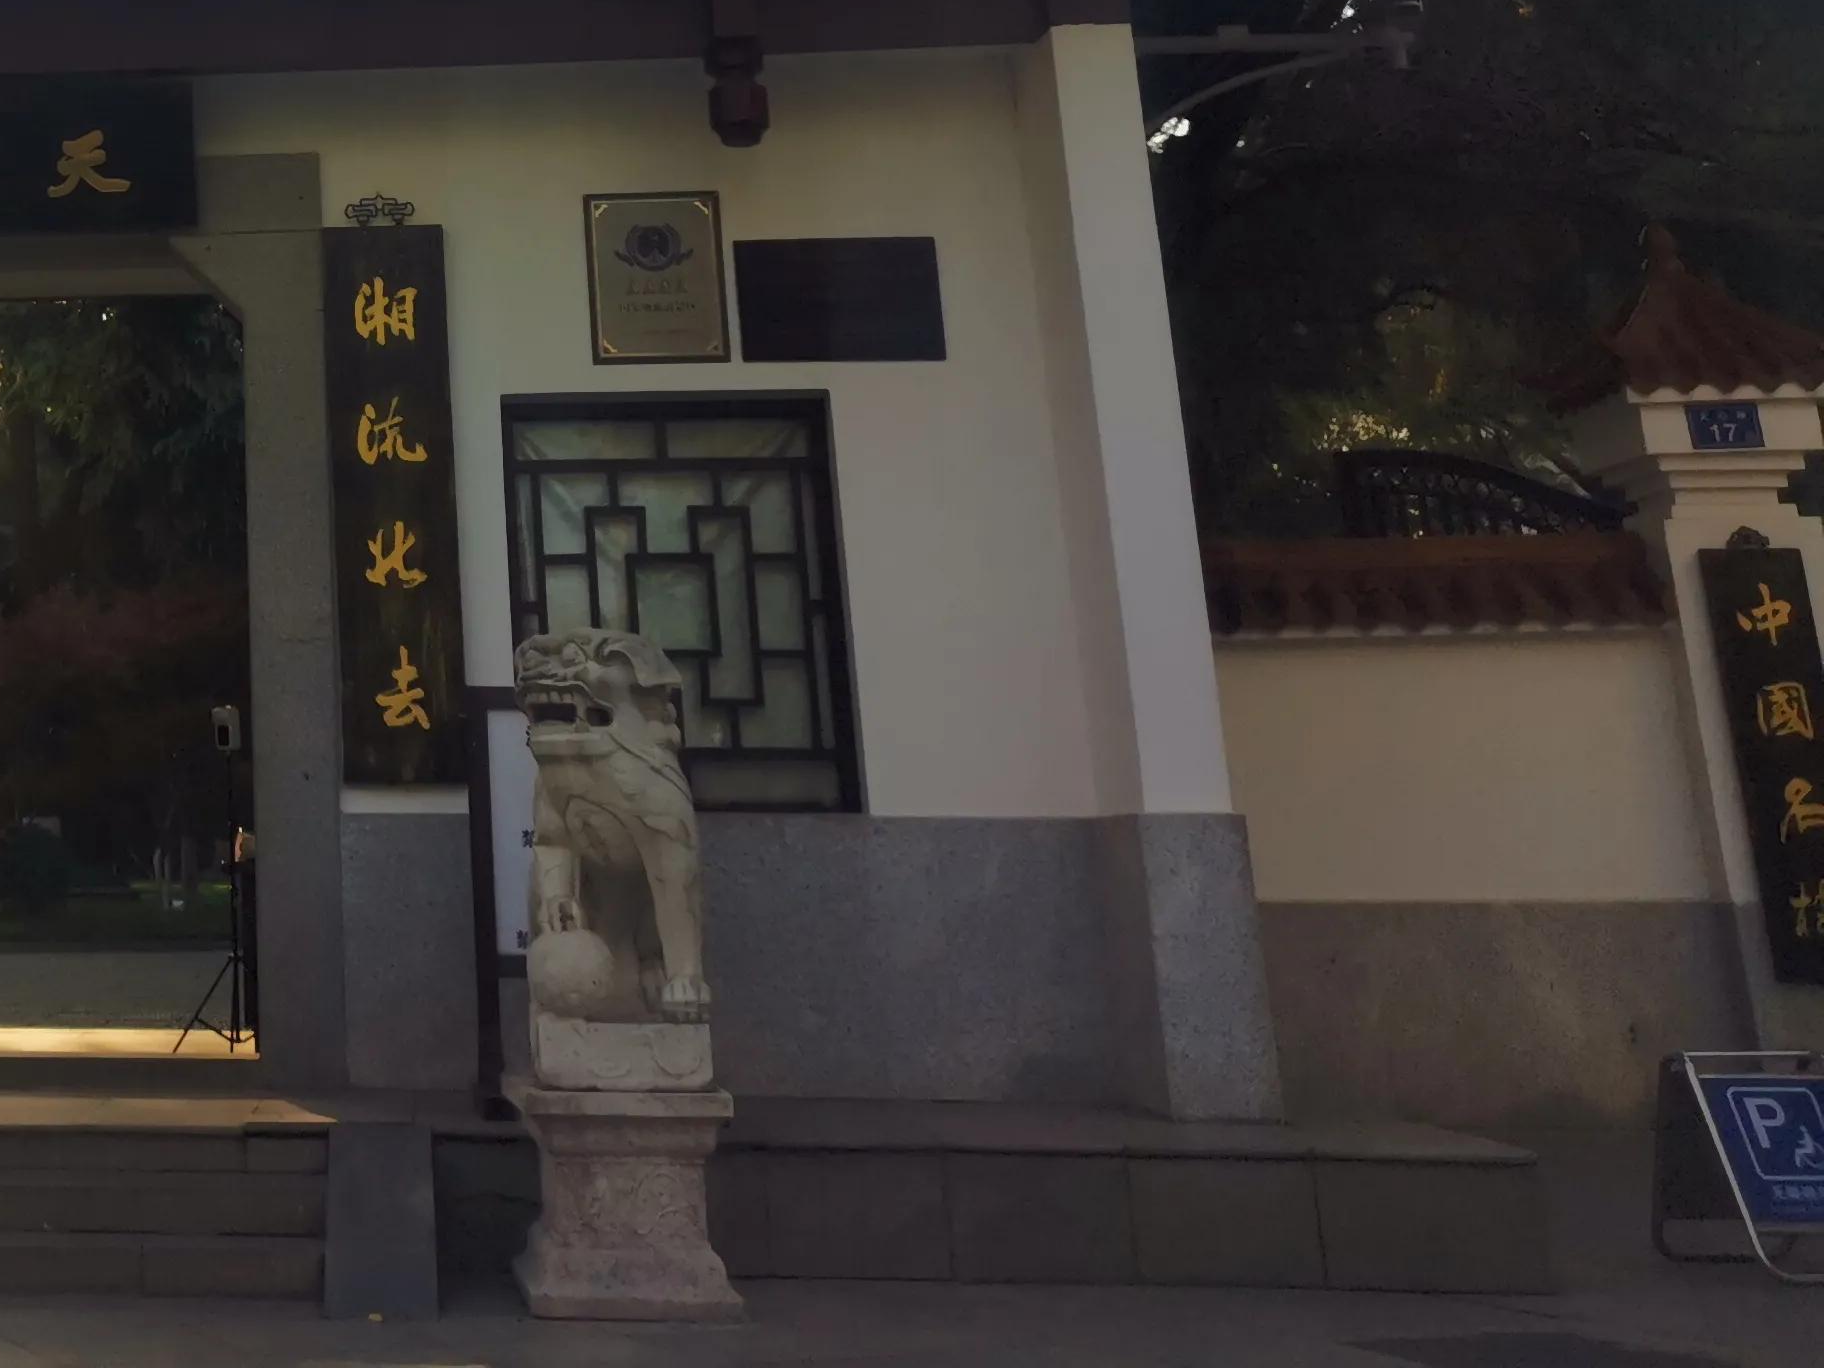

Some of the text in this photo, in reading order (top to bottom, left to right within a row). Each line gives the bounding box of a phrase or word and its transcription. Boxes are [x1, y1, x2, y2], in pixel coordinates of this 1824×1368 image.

[1709, 422, 1737, 443] 17
[354, 276, 431, 731] 湘流北去
[1742, 1096, 1786, 1149] P
